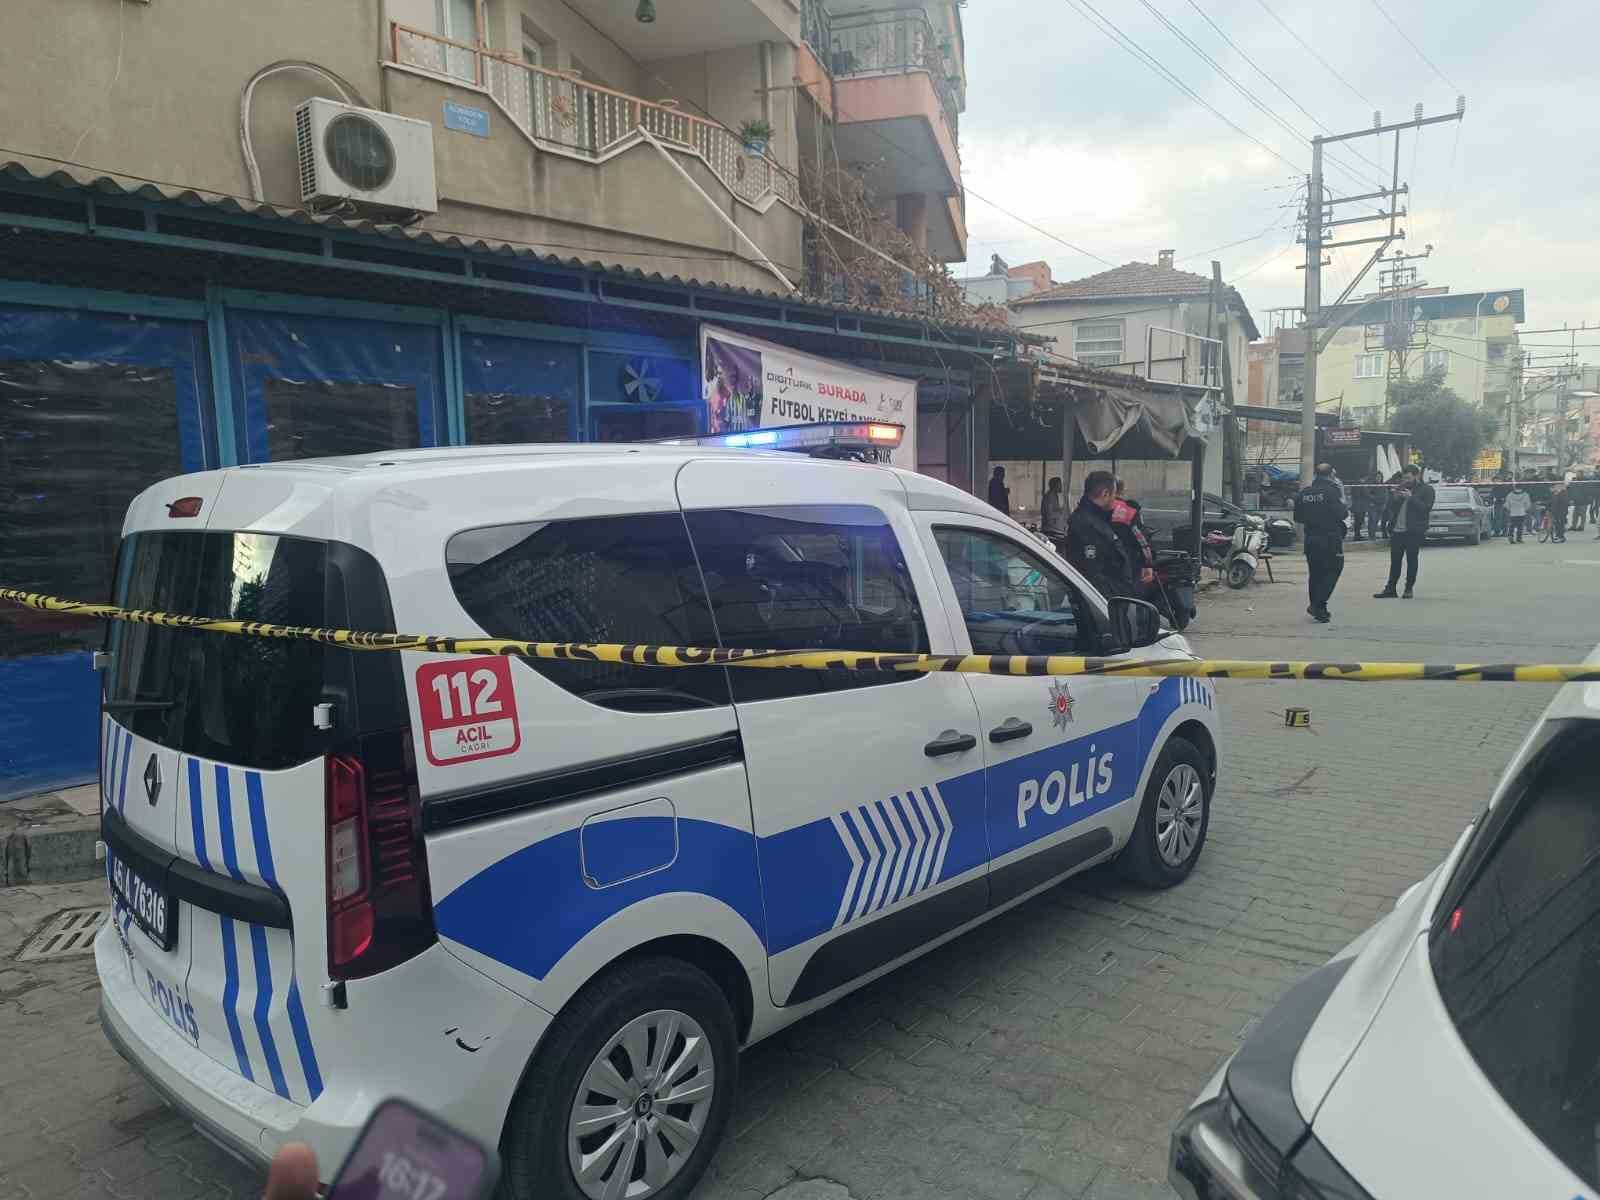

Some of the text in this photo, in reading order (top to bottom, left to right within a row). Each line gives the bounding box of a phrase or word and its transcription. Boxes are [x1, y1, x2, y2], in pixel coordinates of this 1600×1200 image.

[771, 397, 815, 421] FUTBOL
[818, 383, 866, 404] BURADA
[432, 669, 502, 720] 112
[1017, 744, 1114, 828] POLİS
[134, 875, 165, 934] 76316
[147, 967, 200, 1040] POLİS
